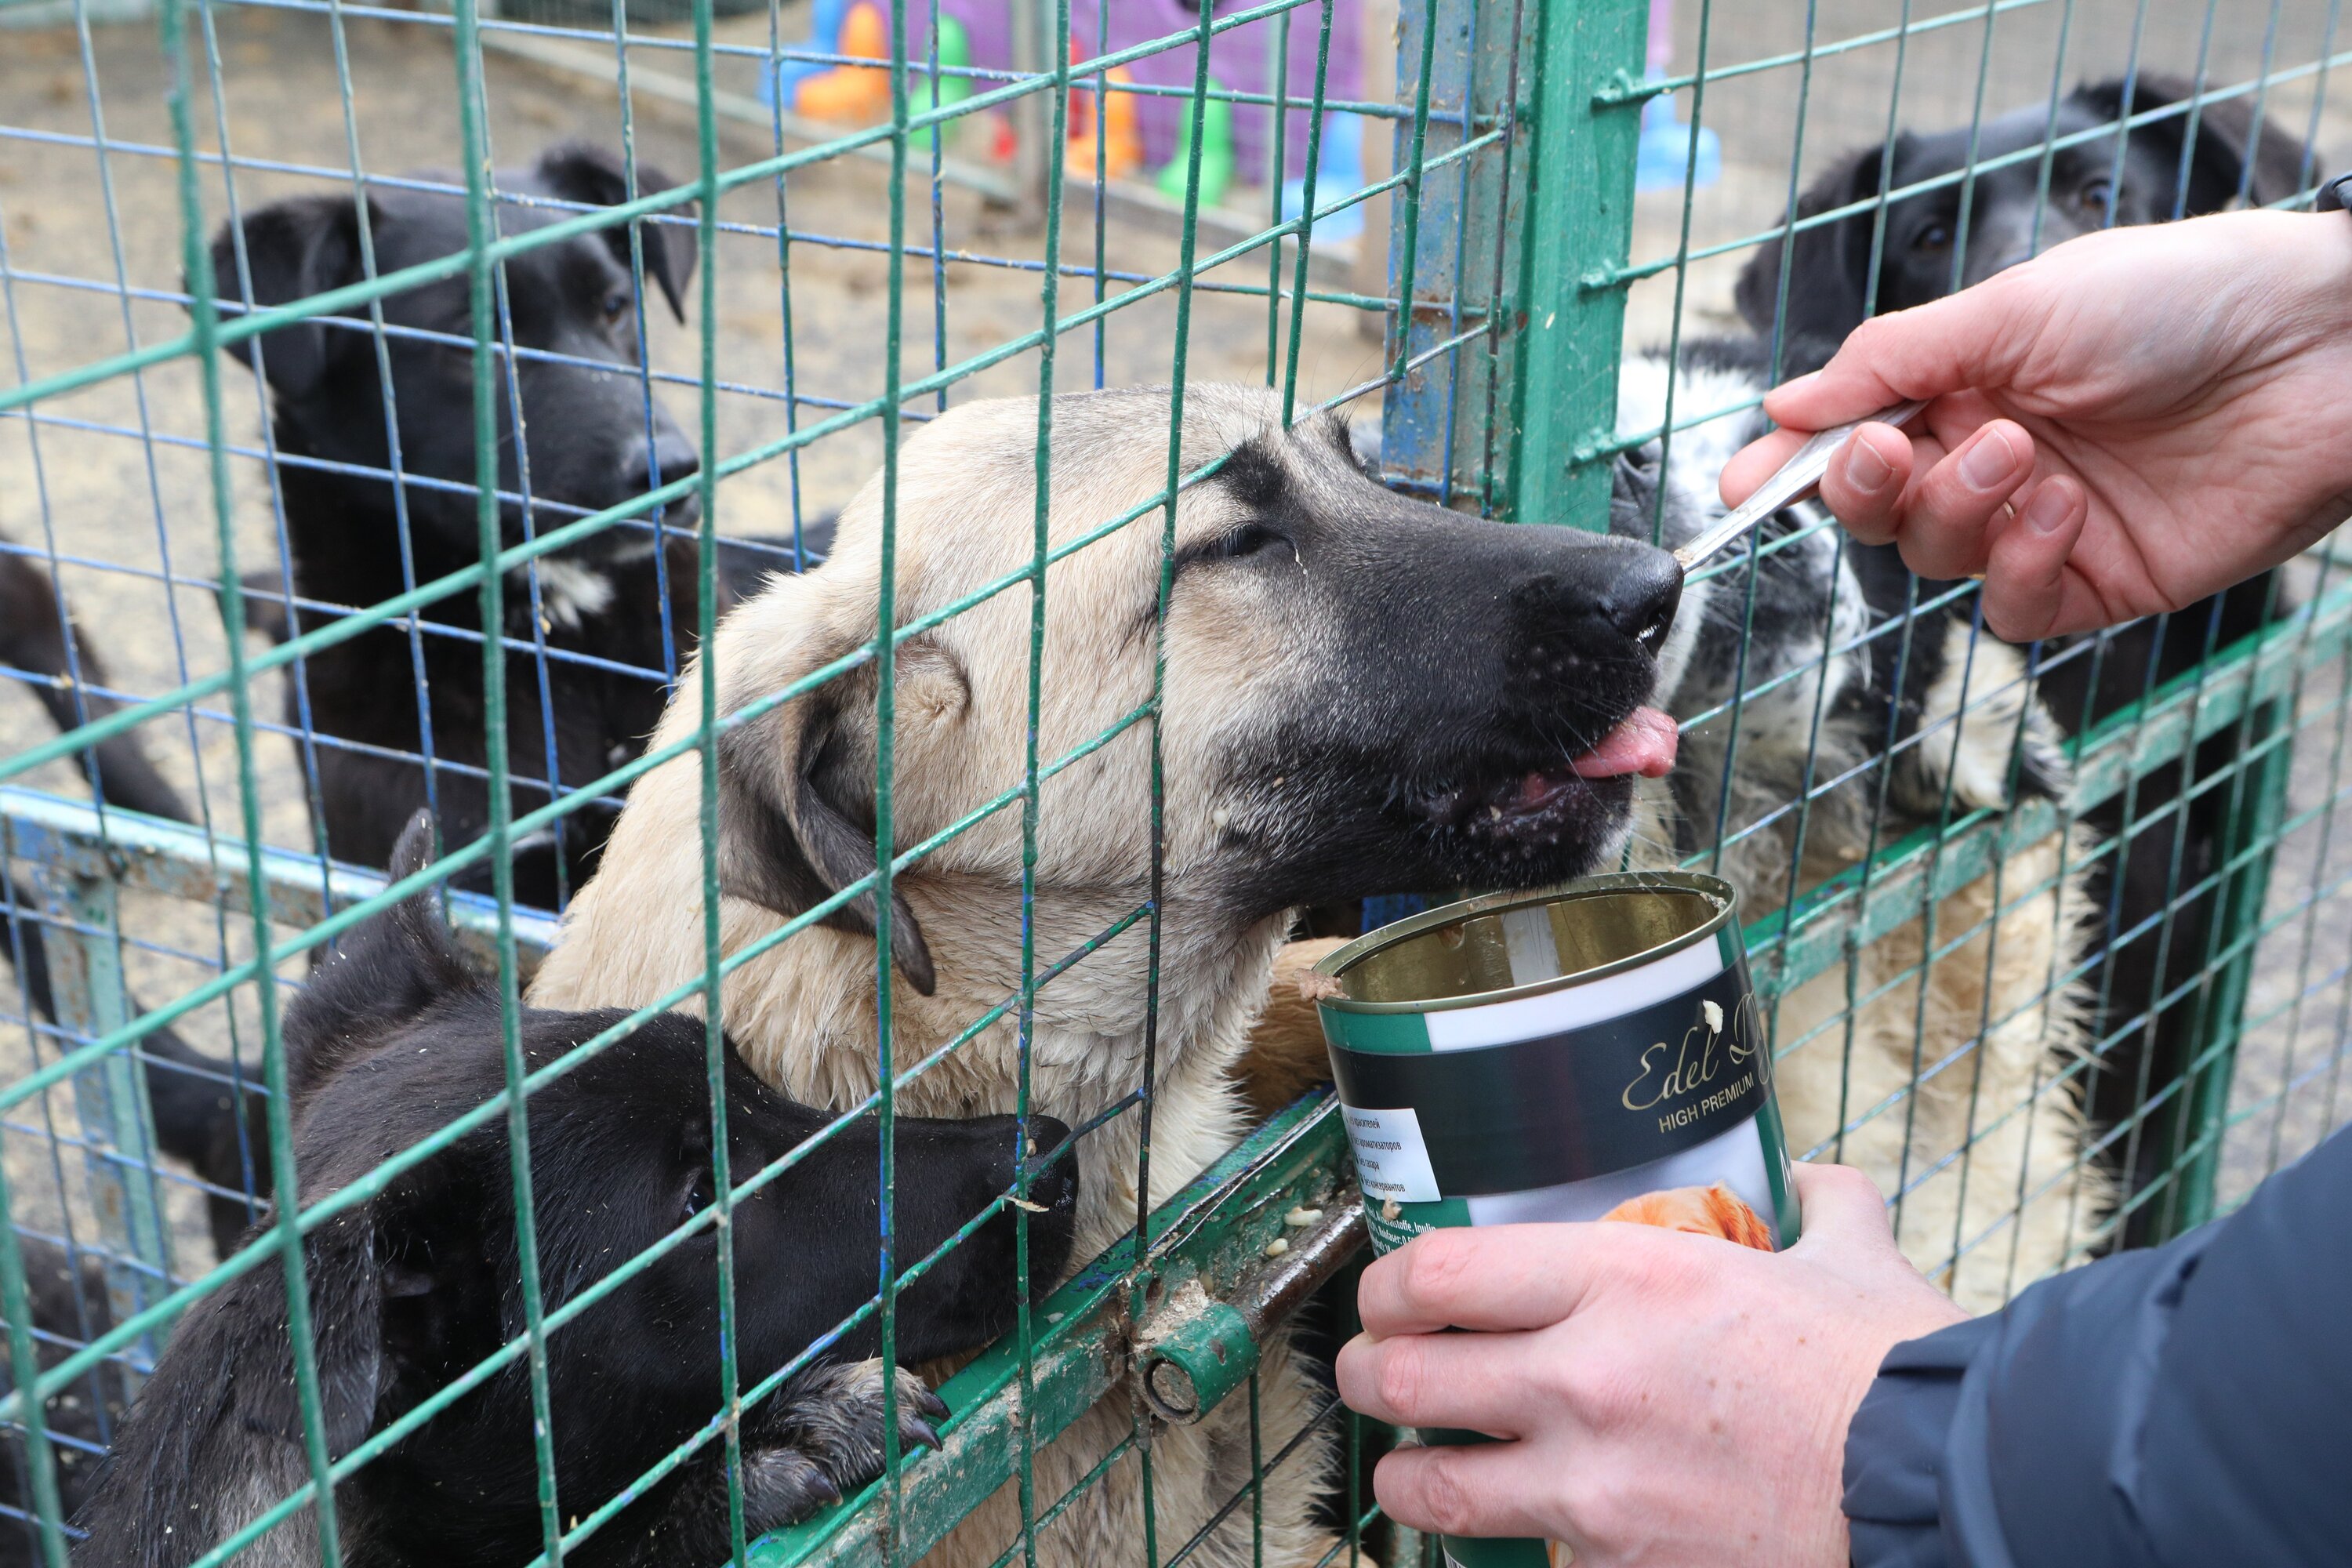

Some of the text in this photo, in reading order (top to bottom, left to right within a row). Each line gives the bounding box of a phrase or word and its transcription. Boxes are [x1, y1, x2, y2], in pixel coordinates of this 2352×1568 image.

[1622, 1025, 1720, 1111] Edel
[1658, 1071, 1755, 1134] HIGH PREMIUM
[1359, 1138, 1402, 1152] ароматизаторов
[1365, 1159, 1380, 1171] сахара
[1370, 1179, 1405, 1192] консервантов
